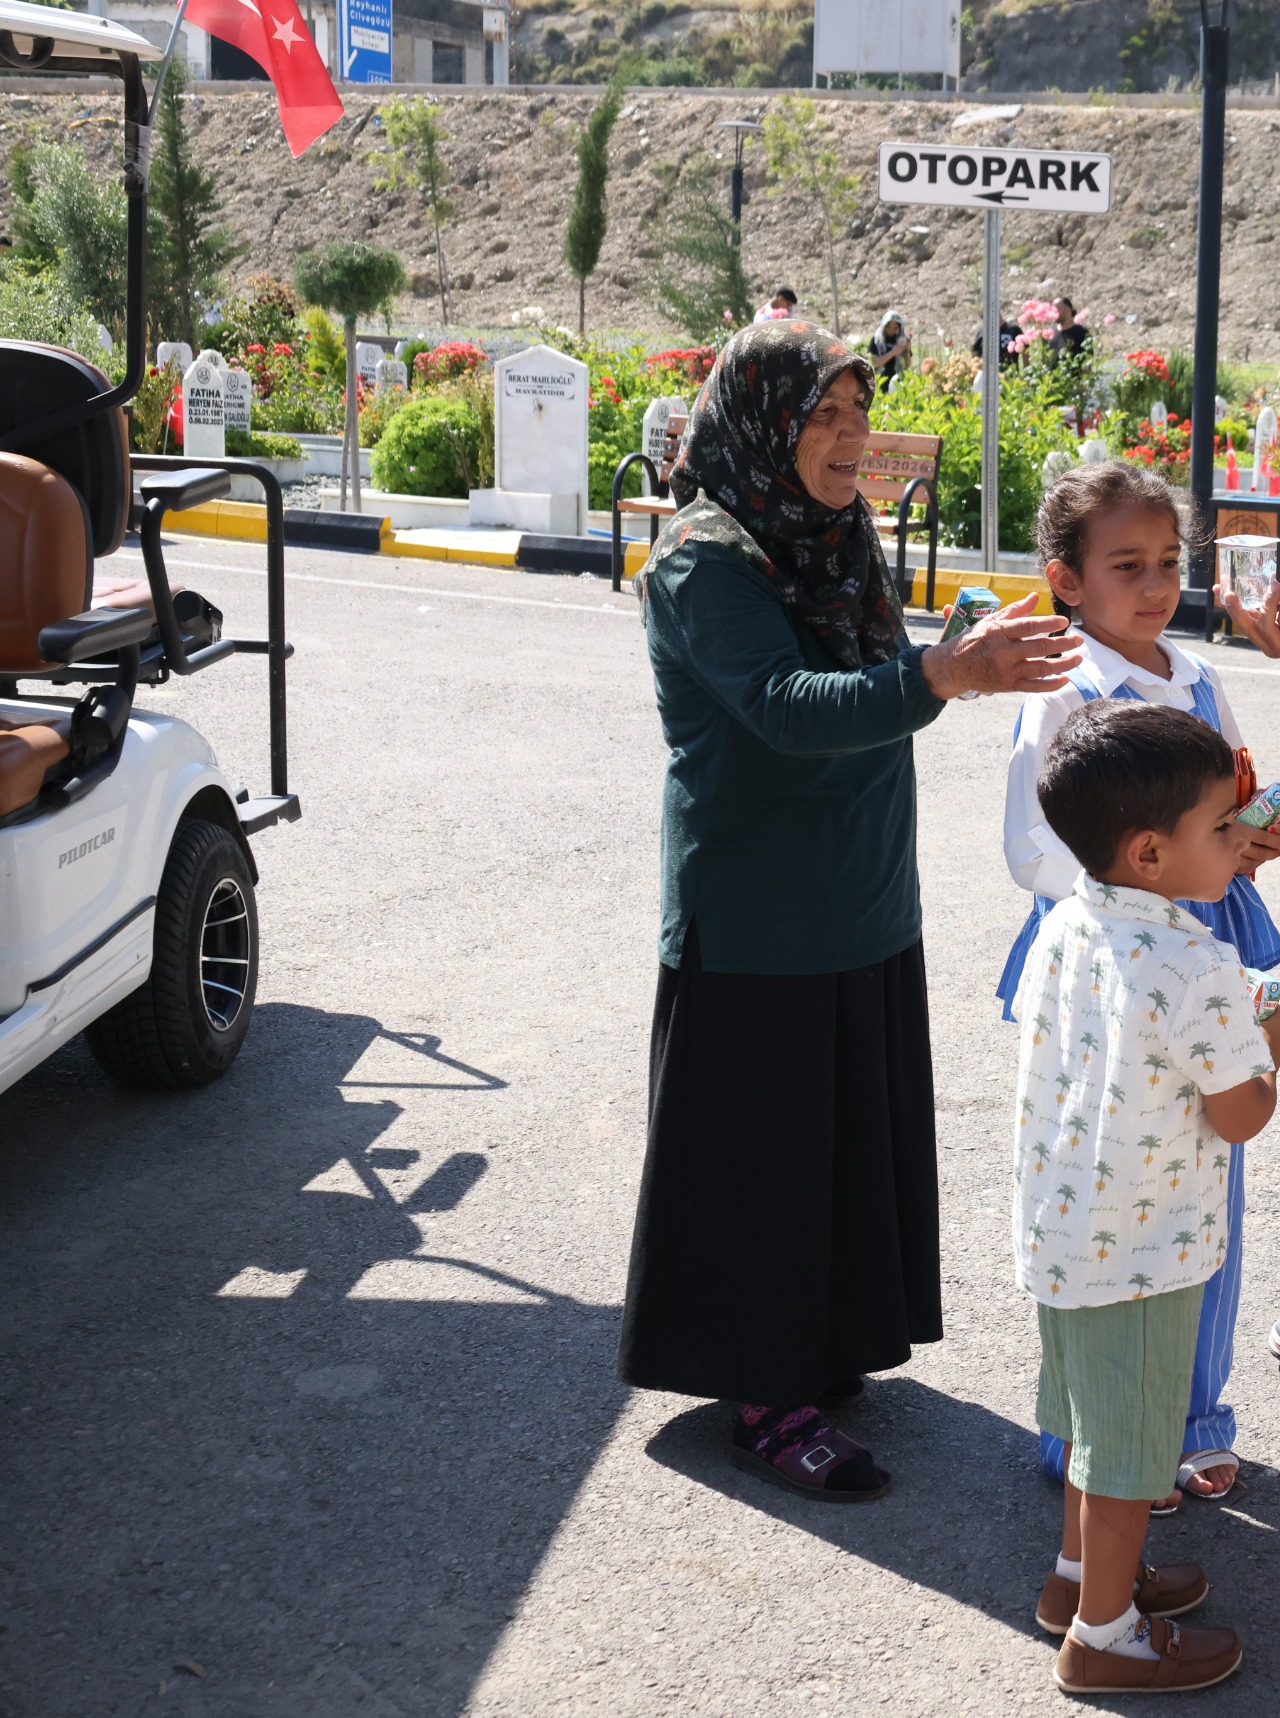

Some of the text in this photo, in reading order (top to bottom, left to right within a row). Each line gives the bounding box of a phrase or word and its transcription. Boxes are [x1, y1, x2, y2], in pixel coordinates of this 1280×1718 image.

[888, 151, 1101, 193] OTOPARK
[508, 374, 530, 383] BERAT
[188, 398, 211, 408] MERYEM
[58, 827, 115, 870] PILOTCAR
